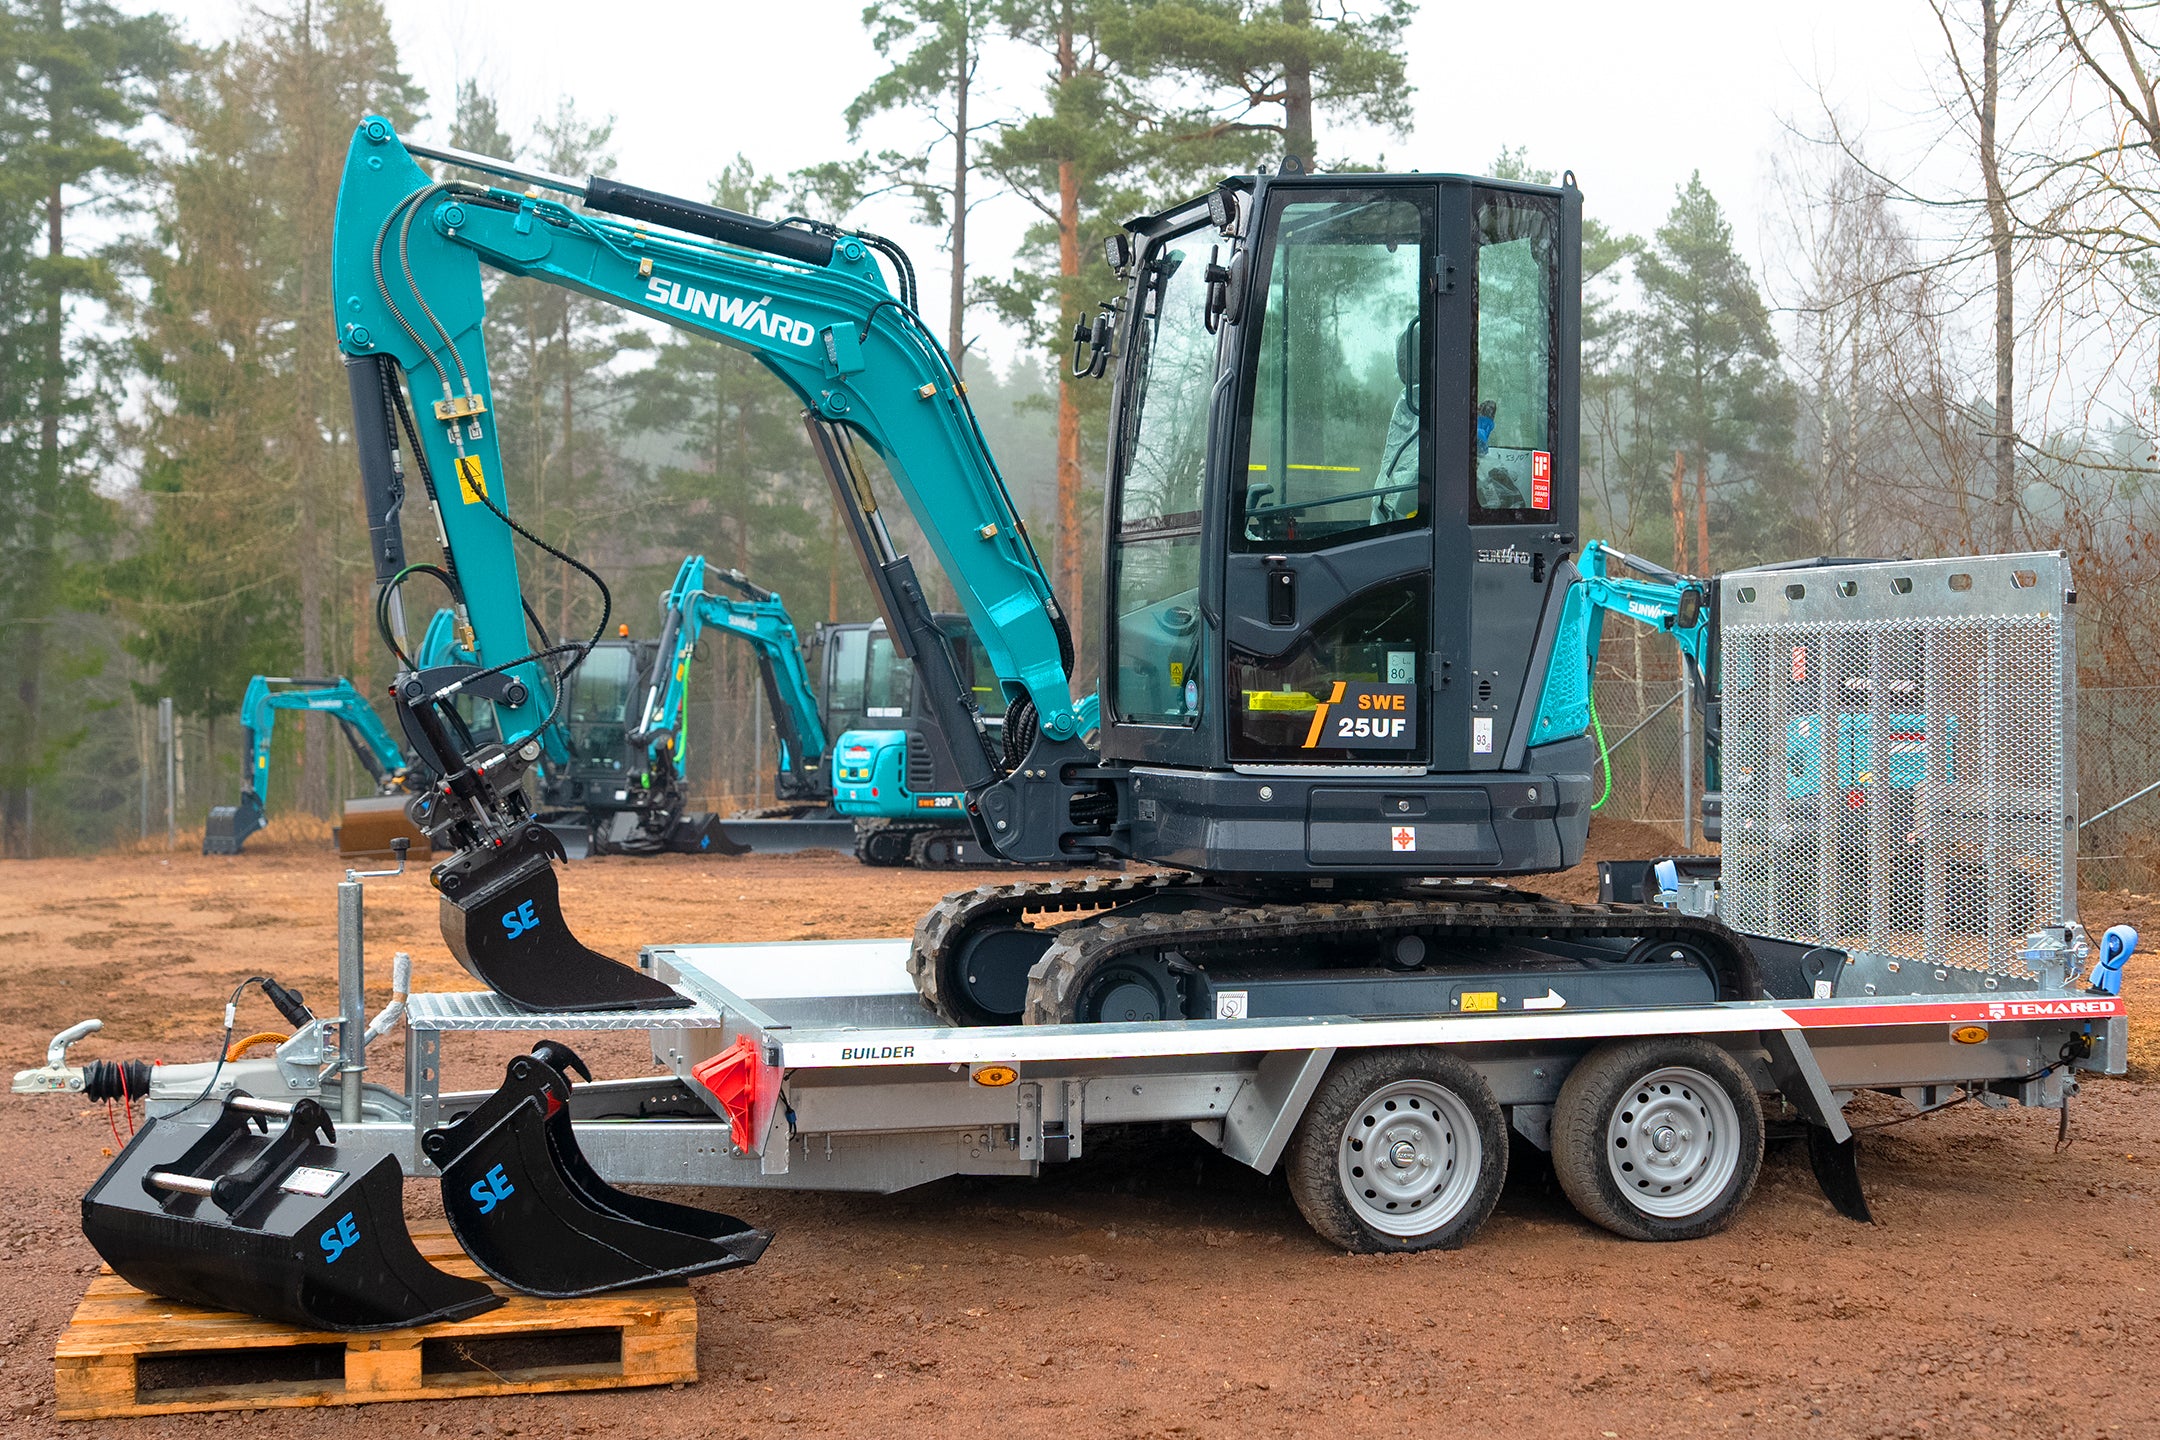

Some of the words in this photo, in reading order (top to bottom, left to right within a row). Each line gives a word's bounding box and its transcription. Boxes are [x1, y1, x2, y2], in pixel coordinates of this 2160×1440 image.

[645, 276, 815, 347] SUNWARD
[1478, 544, 1530, 564] SUNWARD
[1391, 668, 1405, 679] 80
[1358, 695, 1406, 710] SWE
[1338, 718, 1406, 737] 25UF
[1476, 734, 1487, 746] 93
[501, 899, 540, 940] SE
[2008, 1001, 2115, 1015] TEMARED
[841, 1046, 915, 1060] BUILDER
[470, 1163, 515, 1214] SE
[320, 1211, 360, 1264] SE
